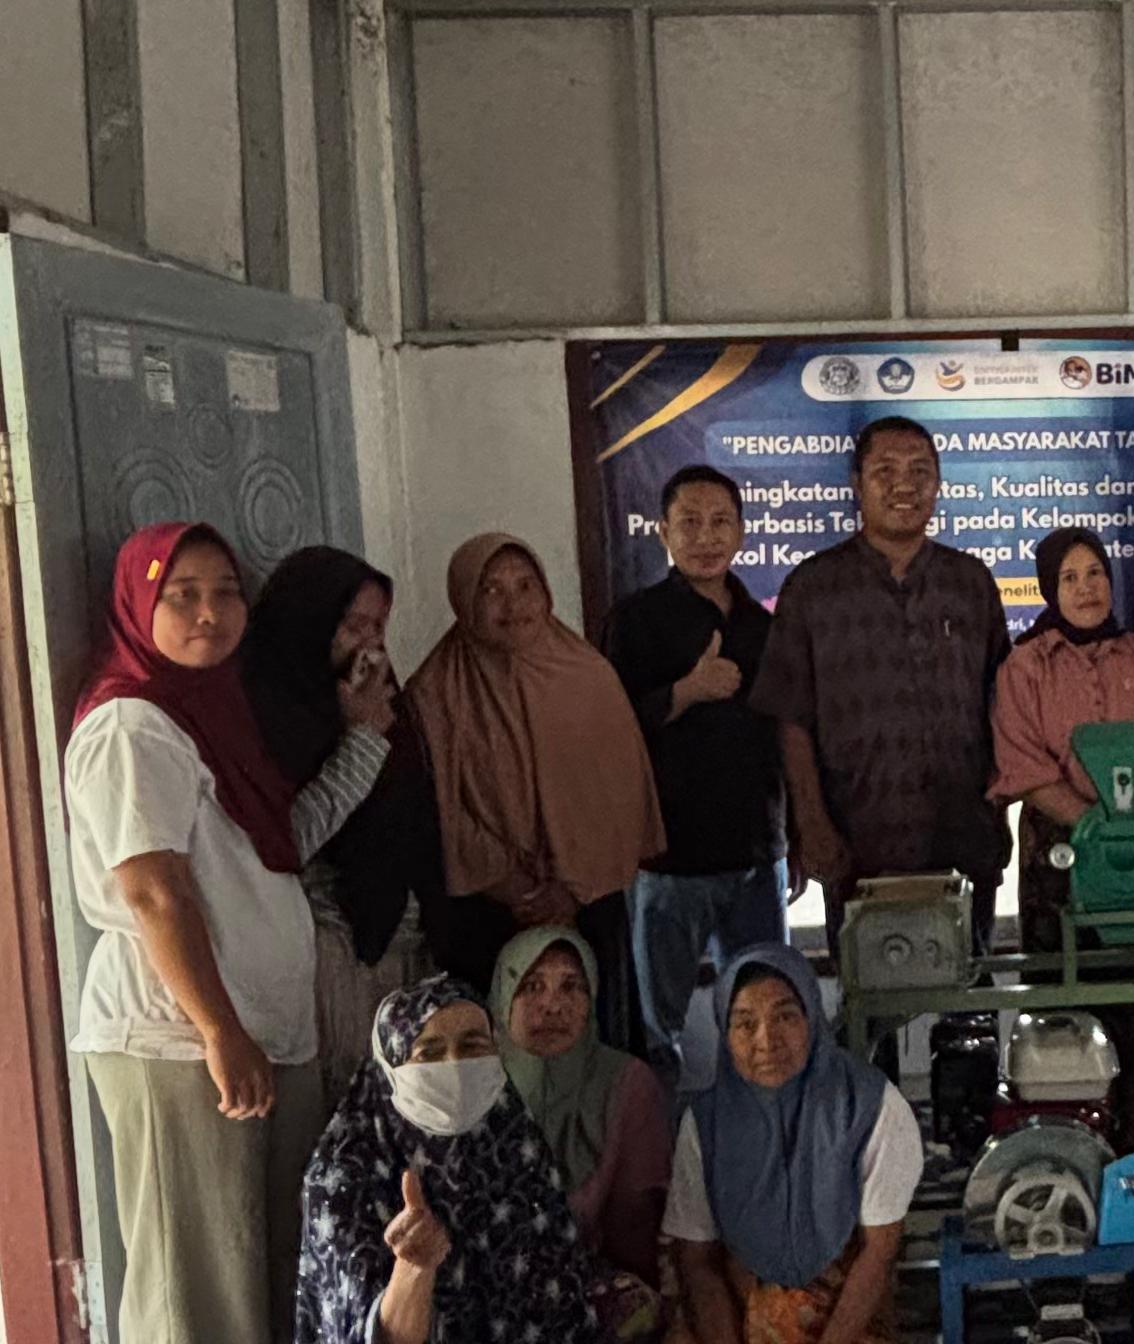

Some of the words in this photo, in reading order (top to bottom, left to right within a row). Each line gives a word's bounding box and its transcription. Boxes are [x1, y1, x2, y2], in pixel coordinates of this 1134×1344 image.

[722, 435, 859, 455] "PENGABDIA
[968, 430, 1111, 452] MASYARAKAT
[991, 475, 1090, 498] Kualitas
[744, 512, 825, 534] erbasis
[953, 508, 1016, 533] pada
